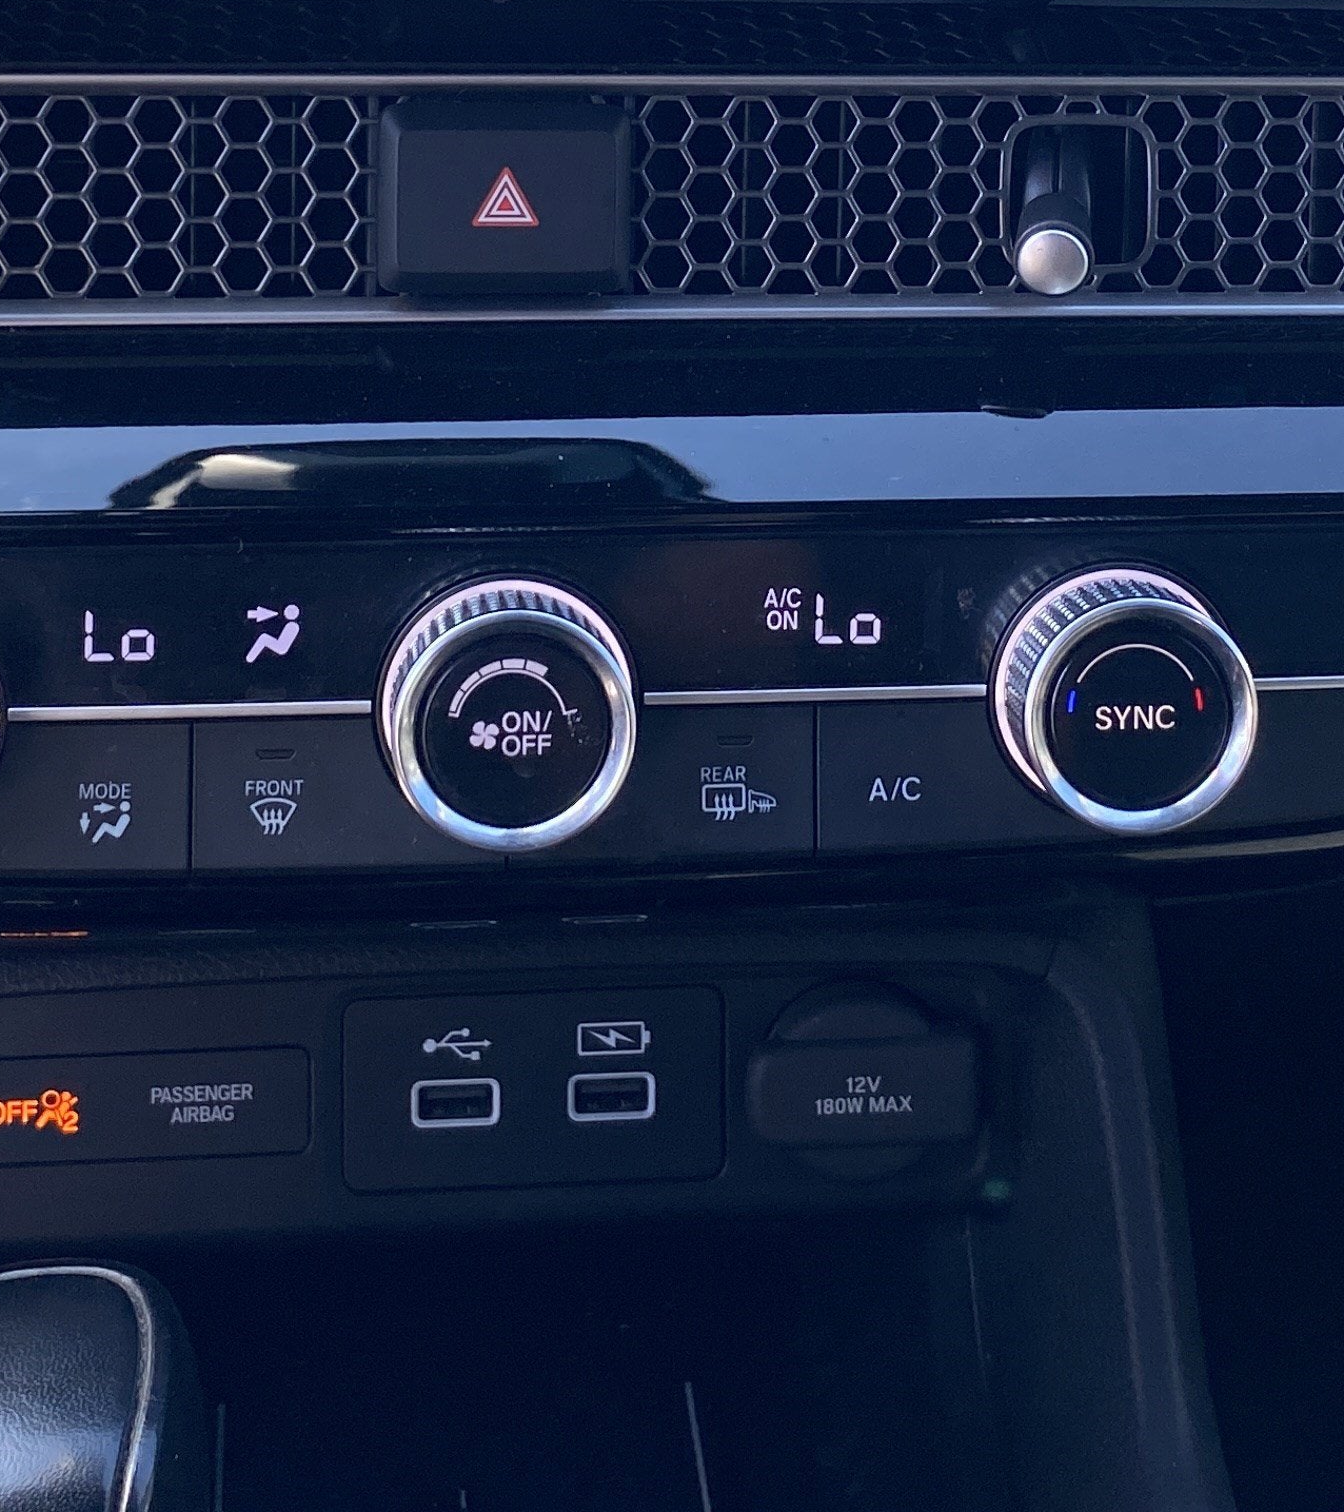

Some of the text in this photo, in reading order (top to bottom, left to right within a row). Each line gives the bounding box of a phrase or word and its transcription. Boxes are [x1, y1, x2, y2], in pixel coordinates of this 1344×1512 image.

[763, 587, 802, 609] A/C
[766, 609, 798, 631] ON
[813, 592, 883, 646] Lo
[82, 609, 157, 665] Lo
[499, 710, 554, 734] ON/
[1095, 704, 1176, 731] SYNC
[500, 733, 553, 758] OFF
[700, 765, 746, 783] REAR
[79, 780, 132, 800] MODE
[245, 779, 304, 797] FRONT
[868, 776, 921, 802] A/C
[151, 1083, 253, 1104] PASSENGER
[846, 1075, 882, 1094] 12V
[170, 1104, 235, 1123] AIRBAG
[814, 1095, 913, 1116] 180W MAX
